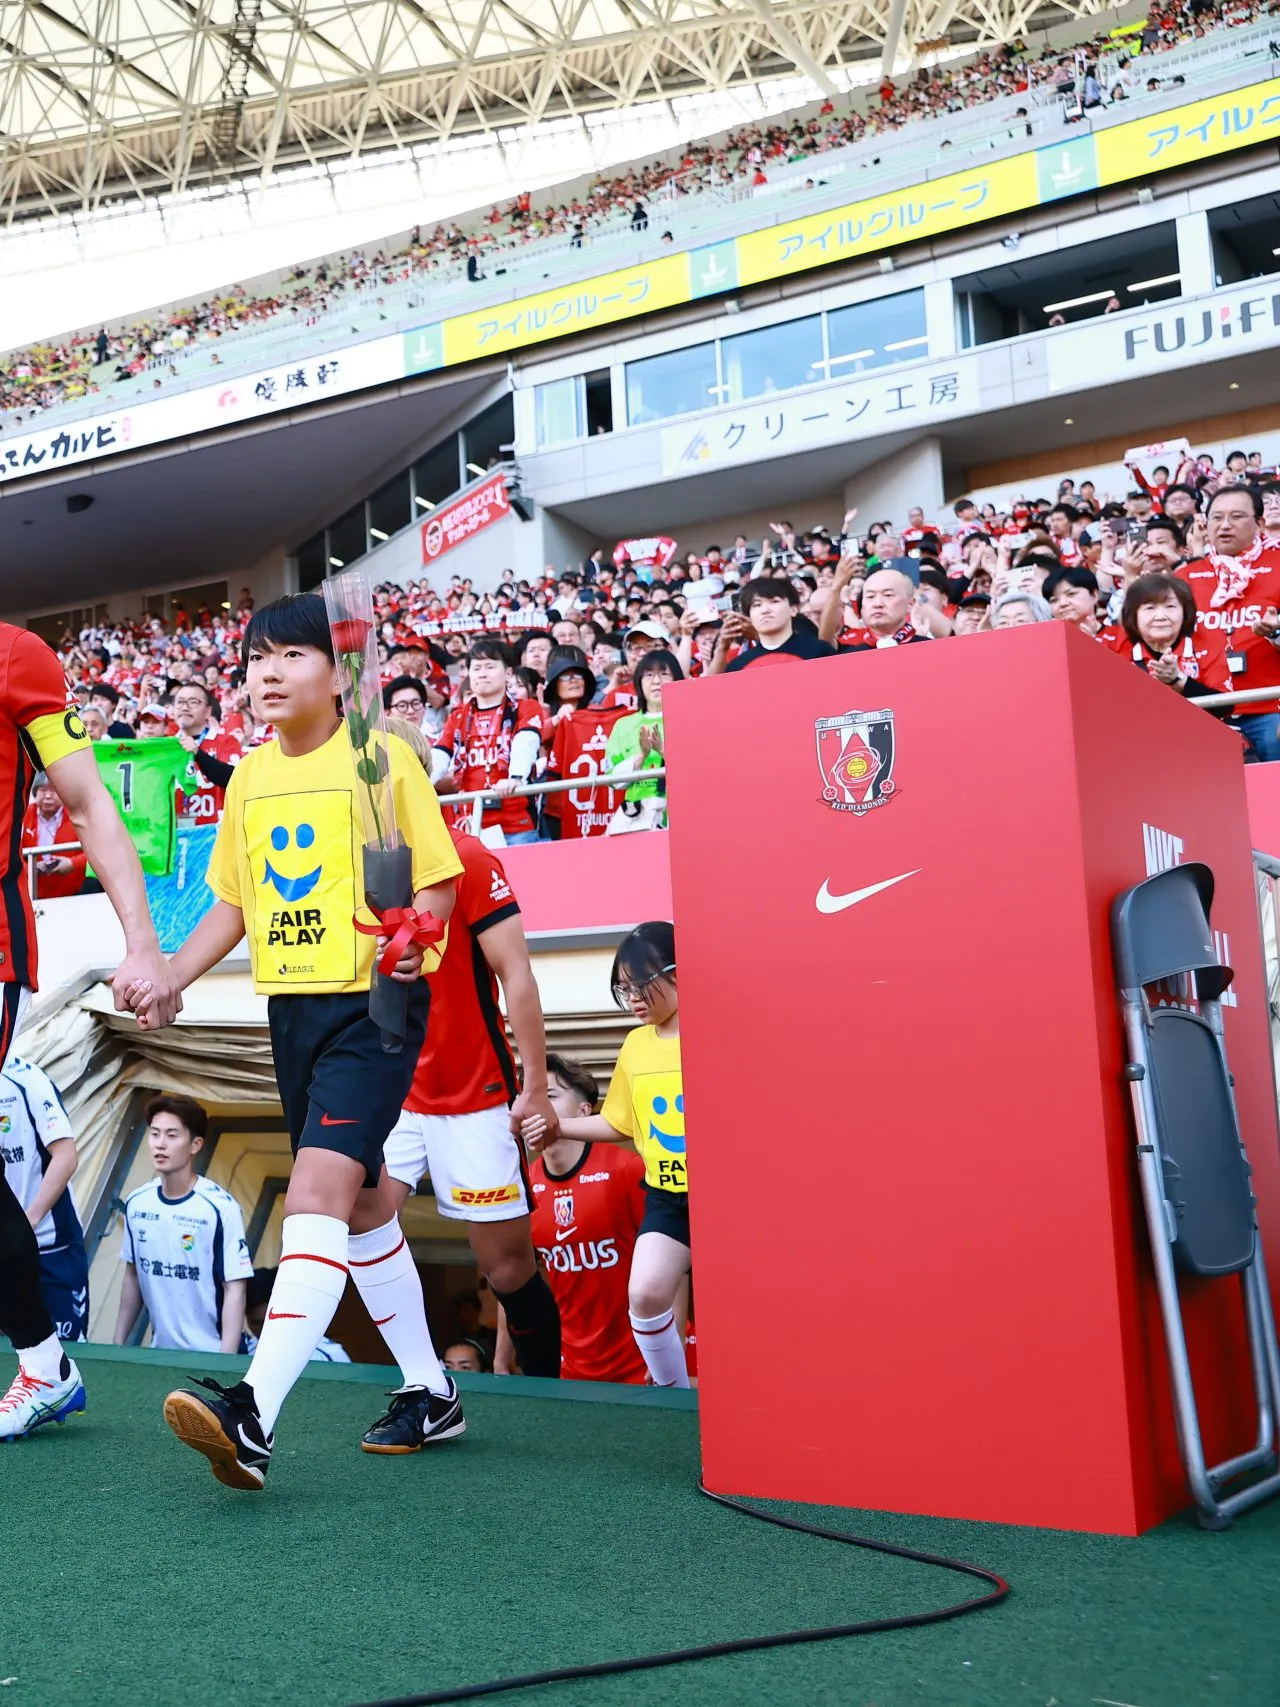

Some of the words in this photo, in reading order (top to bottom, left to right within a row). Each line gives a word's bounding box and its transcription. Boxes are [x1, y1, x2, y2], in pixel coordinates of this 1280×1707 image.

[778, 181, 988, 262] アイルグループ
[477, 277, 650, 345] アイルグループ
[723, 371, 960, 450] クリーン工房
[1194, 605, 1262, 632] POLUS
[117, 762, 134, 812] 1
[189, 794, 215, 817] 20
[848, 796, 888, 811] DIAMONDS
[271, 909, 322, 928] FAIR
[267, 927, 327, 947] PLAY
[658, 1159, 686, 1173] FA
[458, 1189, 512, 1204] DHL
[537, 1238, 619, 1273] POLUS
